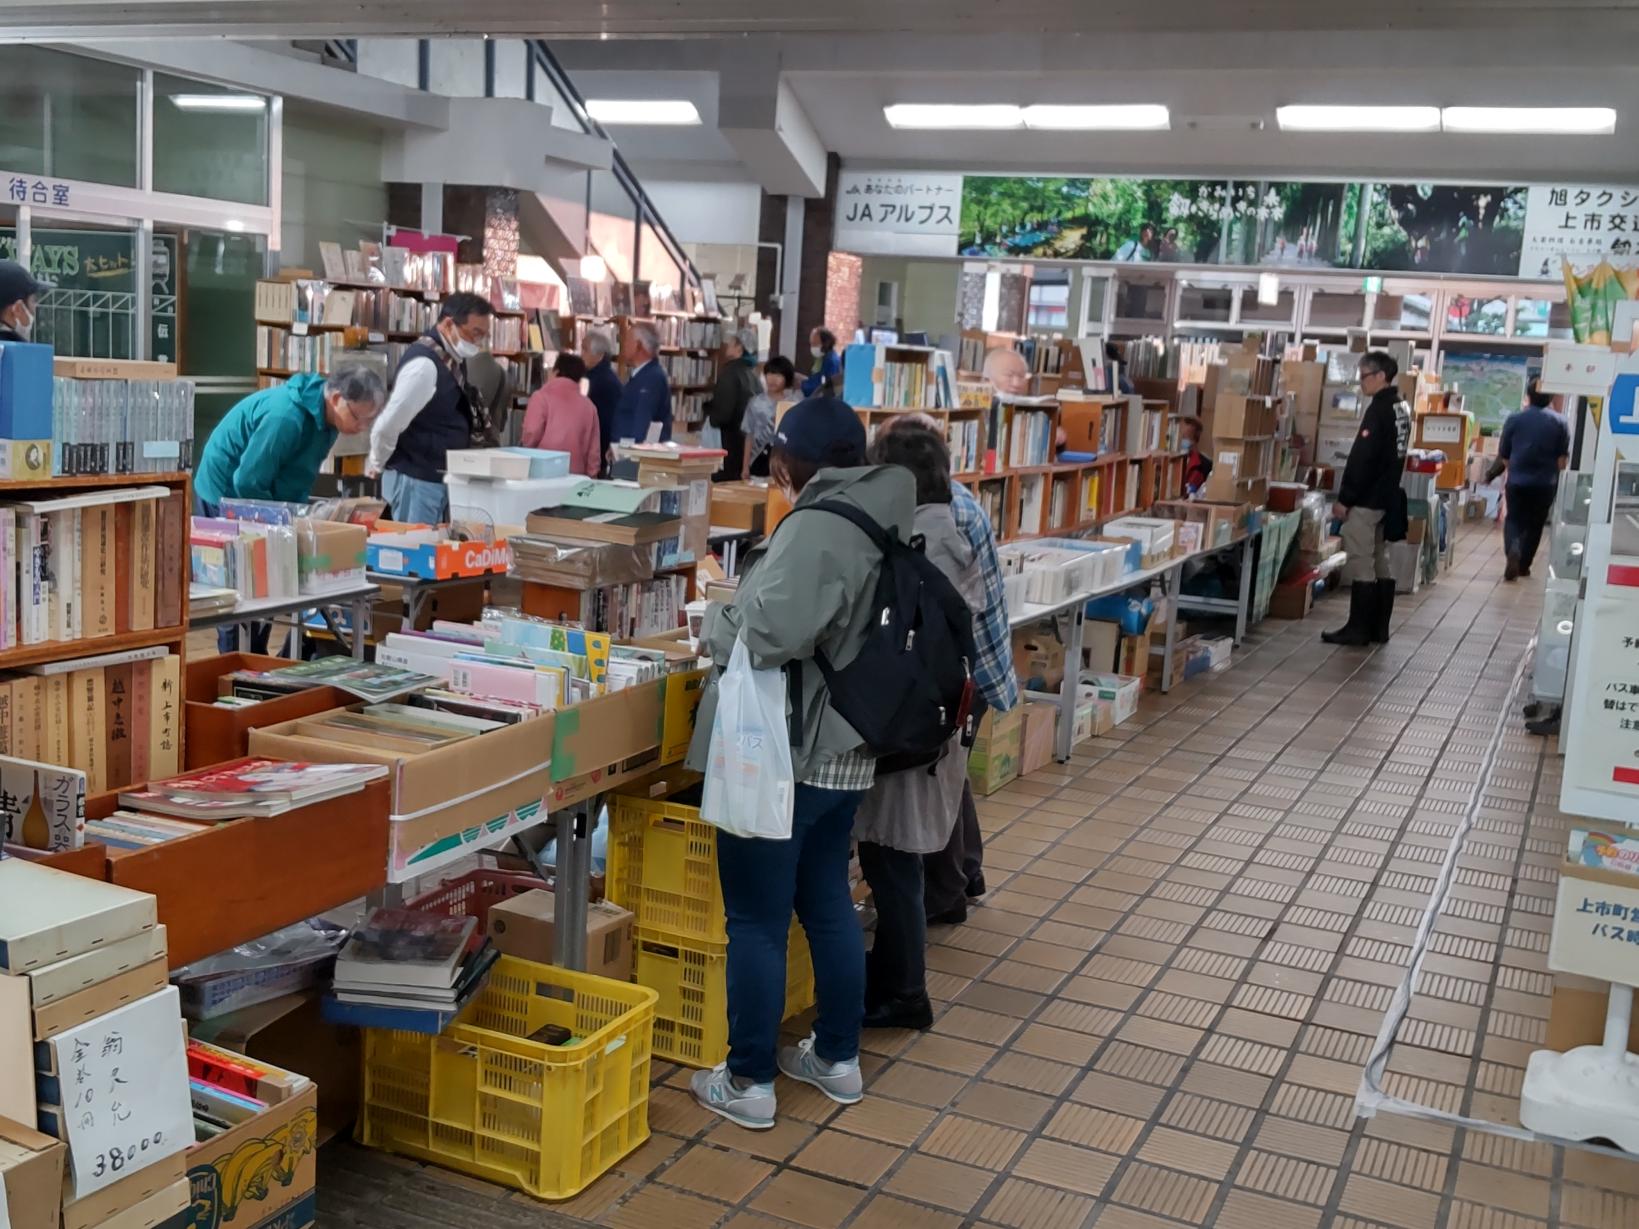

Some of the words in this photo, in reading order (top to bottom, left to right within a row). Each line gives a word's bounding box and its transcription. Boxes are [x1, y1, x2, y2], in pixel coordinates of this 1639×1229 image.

[9, 177, 70, 207] 待合室
[1548, 187, 1638, 208] 旭タクシ
